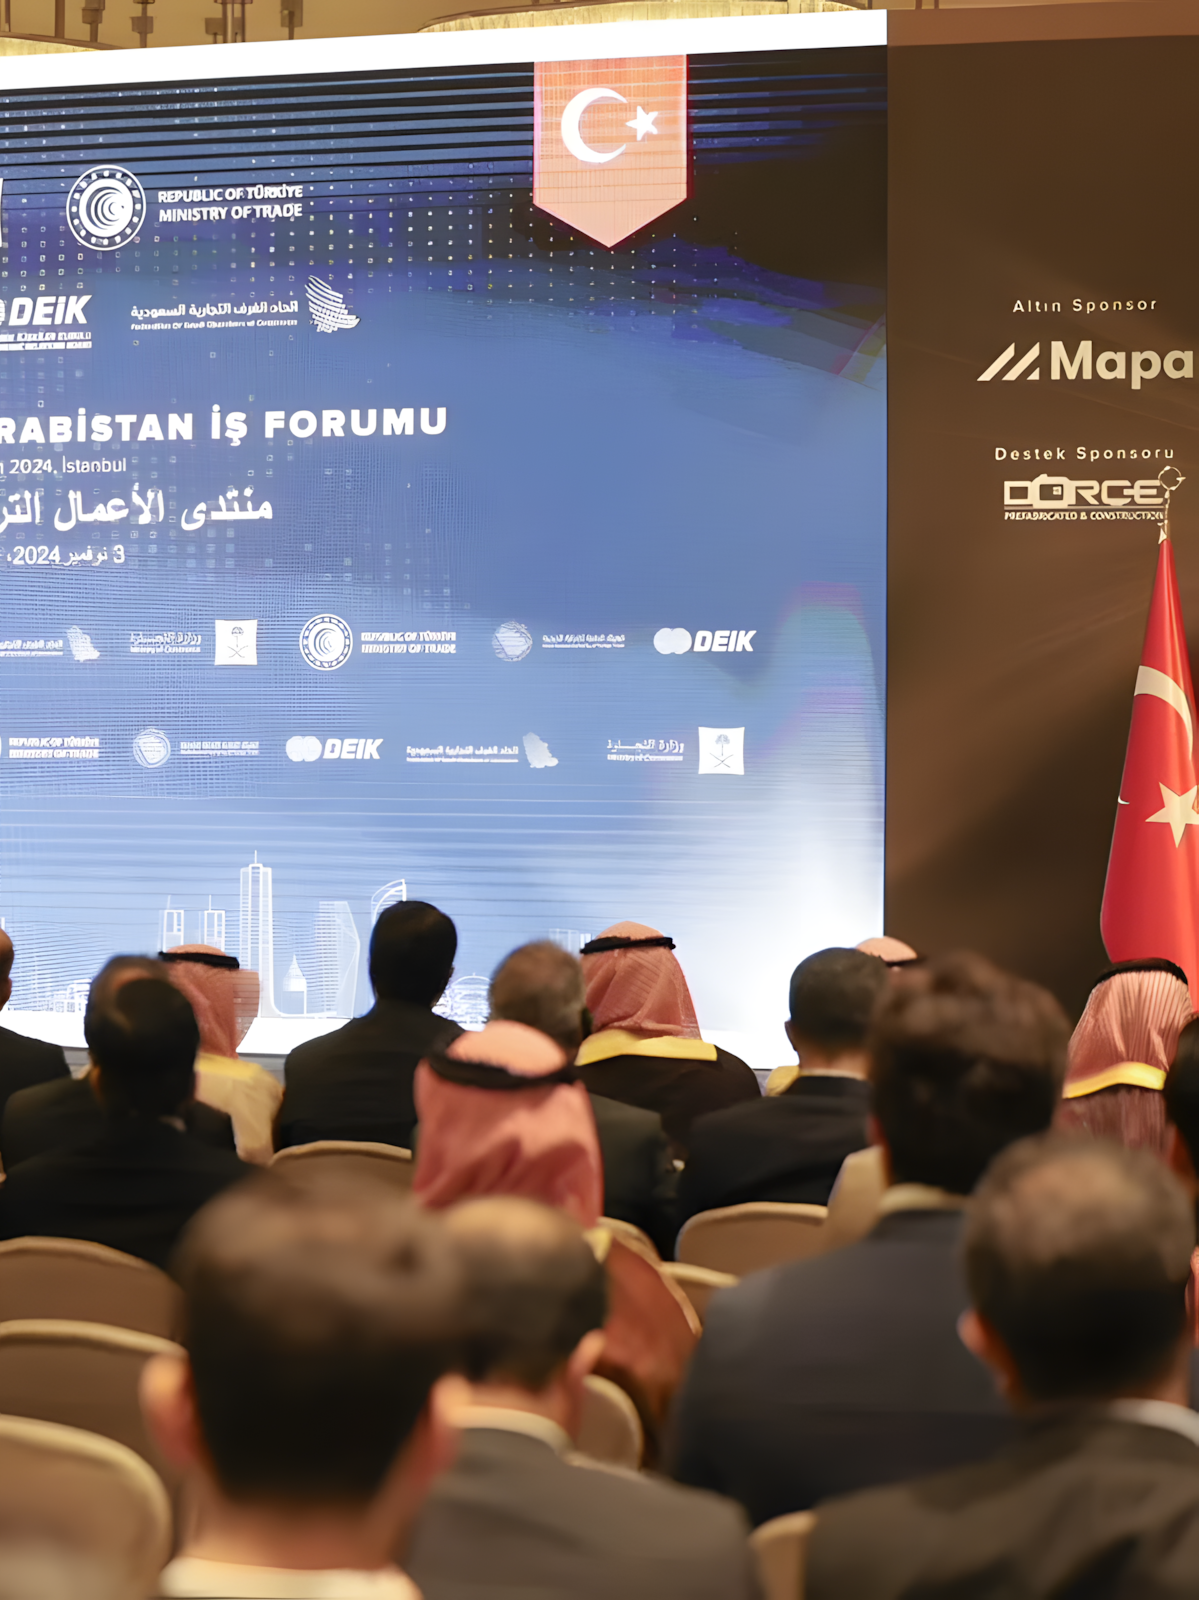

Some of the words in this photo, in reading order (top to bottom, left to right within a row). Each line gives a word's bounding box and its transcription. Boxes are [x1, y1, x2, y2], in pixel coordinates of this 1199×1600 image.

[158, 188, 223, 204] REPUBLIC
[159, 206, 228, 222] MINISTRY
[252, 203, 302, 218] TRADE
[1072, 299, 1157, 314] Sponsor
[1051, 340, 1194, 390] Mapa
[211, 404, 248, 447] İŞ
[264, 407, 447, 439] FORUMU
[995, 447, 1066, 461] Destek
[1076, 447, 1174, 463] Sponsoru
[54, 482, 165, 532] الأعمال
[181, 486, 273, 532] منتدى
